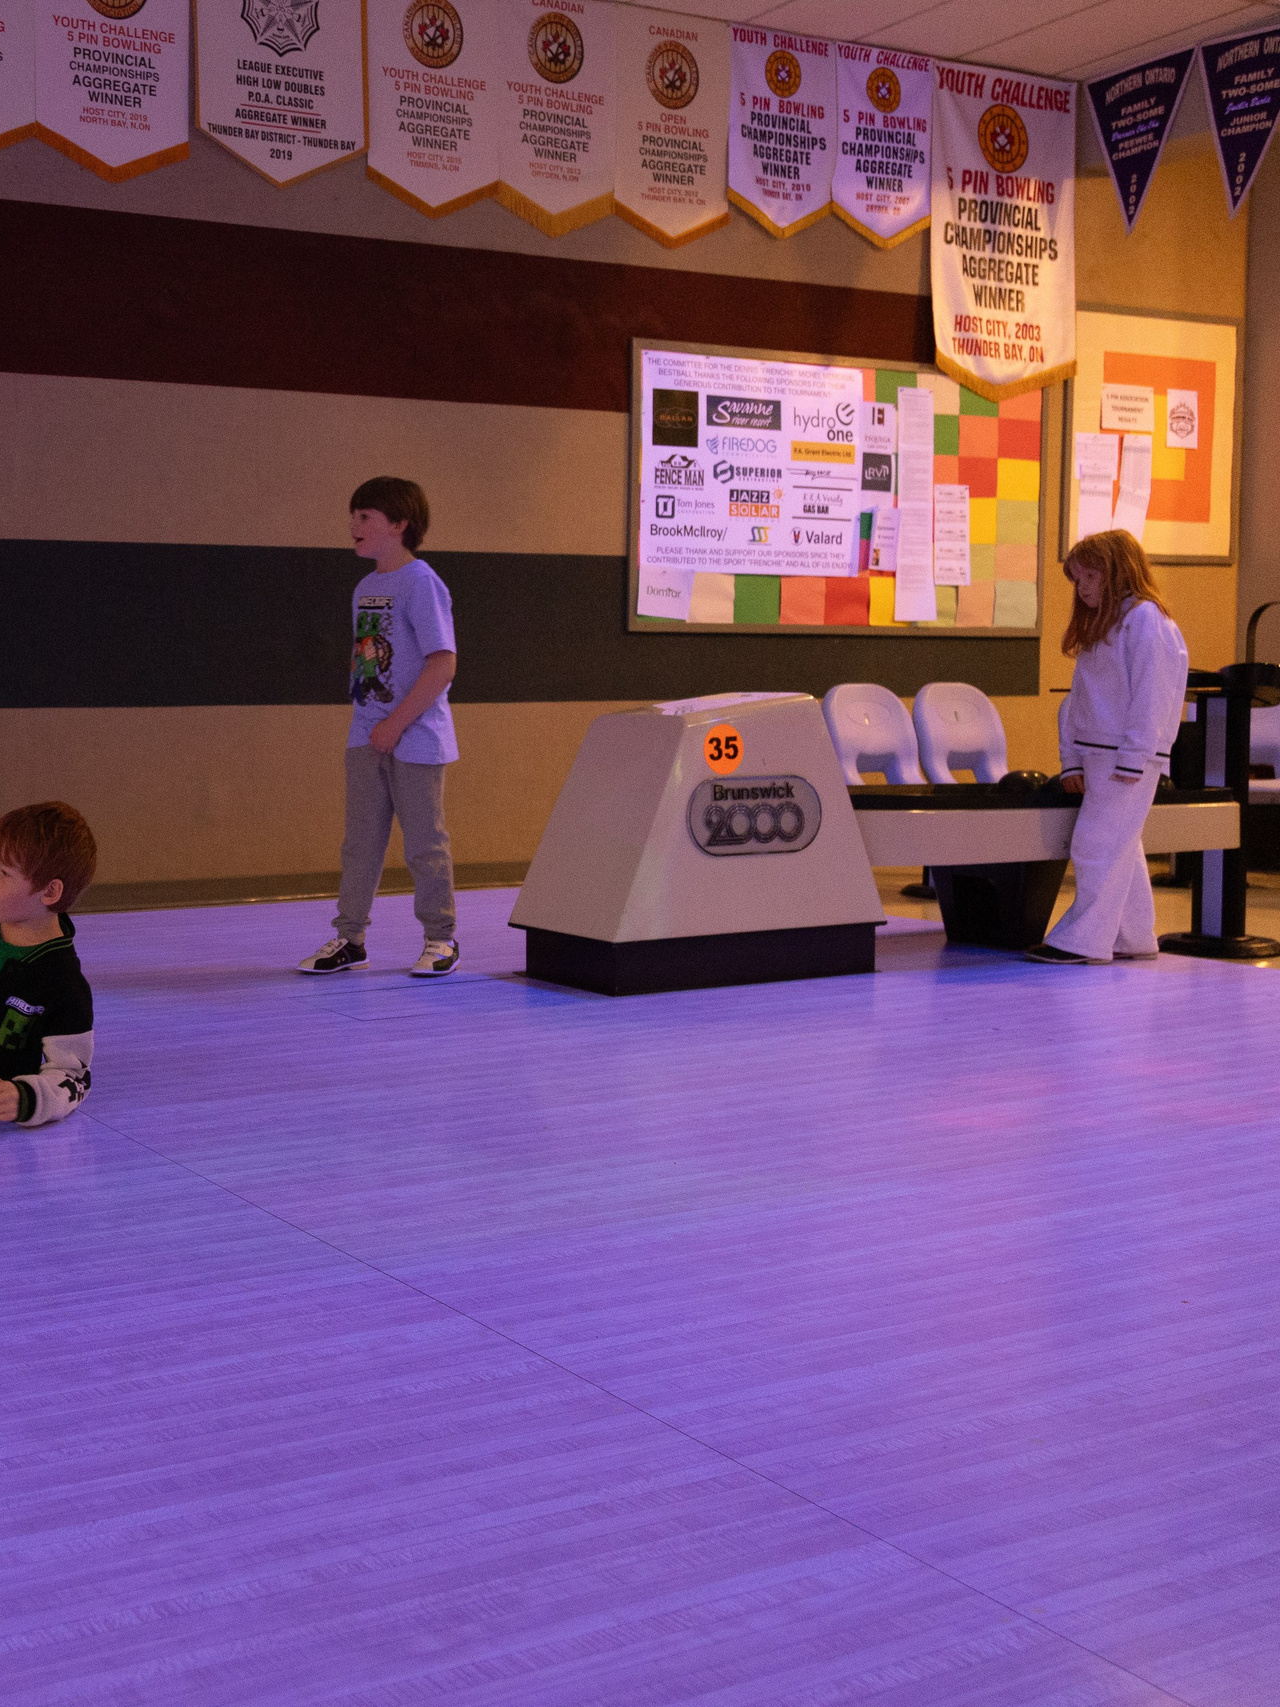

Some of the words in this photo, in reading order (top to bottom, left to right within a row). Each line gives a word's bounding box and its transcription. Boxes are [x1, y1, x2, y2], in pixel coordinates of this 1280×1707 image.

[532, 0, 584, 14] CANADIAN
[52, 14, 96, 32] YOUTH
[99, 22, 176, 44] CHALLENGE
[649, 25, 698, 41] CANADIAN
[67, 30, 74, 41] 5
[78, 32, 98, 46] PIN
[102, 36, 162, 54] BOWLING
[732, 27, 767, 46] YOUTH
[773, 33, 829, 58] CHALLENGE
[73, 47, 156, 69] PROVINCIAL
[837, 43, 871, 63] YOUTH
[876, 50, 930, 72] CHALLENGE
[69, 60, 160, 82] CHAMPIONSHIPS
[237, 59, 272, 74] LEAGUE
[275, 64, 324, 81] EXECUTIVE
[382, 66, 419, 81] YOUTH
[421, 72, 486, 91] CHALLENGE
[1234, 67, 1275, 85] FAMILY
[72, 74, 157, 97] AGGREGATE
[236, 74, 259, 88] HIGH
[261, 78, 281, 90] LOW
[284, 81, 325, 96] DOUBLES
[394, 81, 401, 90] 5
[403, 82, 421, 94] PIN
[424, 85, 475, 101] BOWLING
[506, 81, 542, 95] YOUTH
[544, 86, 605, 106] CHALLENGE
[936, 65, 986, 99] YOUTH
[991, 78, 1071, 114] CHALLENGE
[88, 90, 142, 109] WINNER
[248, 91, 273, 104] P.O.A.
[276, 94, 314, 110] CLASSIC
[399, 95, 469, 116] PROVINCIAL
[518, 94, 524, 104] 5
[526, 95, 543, 108] PIN
[546, 98, 593, 116] BOWLING
[740, 92, 746, 106] 5
[752, 95, 771, 111] PIN
[778, 99, 825, 120] BOWLING
[79, 115, 108, 125] NORTH
[82, 106, 105, 116] HOST
[107, 110, 127, 120] CITY,
[235, 108, 288, 125] AGGREGATE
[290, 114, 327, 129] WINNER
[396, 109, 473, 127] CHAMPIONSHIPS
[523, 109, 588, 129] PROVINCIAL
[660, 112, 687, 125] OPEN
[750, 111, 812, 135] PROVINCIAL
[843, 109, 850, 123] 5
[858, 111, 875, 127] PIN
[883, 115, 927, 133] BOWLING
[1230, 111, 1268, 126] JUNIOR
[207, 122, 243, 138] THUNDER
[245, 128, 260, 139] BAY
[260, 130, 296, 144] DISTRICT
[303, 136, 339, 150] THUNDER
[340, 140, 356, 151] BAY
[398, 121, 471, 141] AGGREGATE
[519, 121, 591, 140] CHAMPIONSHIPS
[637, 121, 643, 131] 5
[645, 122, 661, 134] PIN
[664, 124, 709, 139] BOWLING
[741, 124, 827, 151] CHAMPIONSHIPS
[855, 126, 916, 147] PROVINCIAL
[1221, 120, 1273, 137] CHAMPION
[411, 135, 458, 151] WINNER
[521, 133, 590, 153] AGGREGATE
[642, 135, 705, 152] PROVINCIAL
[841, 141, 925, 164] CHAMPIONSHIPS
[269, 148, 293, 160] 2019
[533, 147, 577, 163] WINNER
[639, 147, 708, 162] CHAMPIONSHIPS
[753, 144, 811, 166] AGGREGATE
[641, 159, 706, 176] AGGREGATE
[761, 161, 800, 180] WINNER
[855, 159, 913, 179] AGGREGATE
[652, 171, 694, 186] WINNER
[866, 175, 903, 193] WINNER
[961, 169, 989, 195] PIN
[995, 174, 1055, 205] BOWLING
[958, 197, 1041, 231] PROVINCIAL
[943, 222, 1058, 261] CHAMPIONSHIPS
[962, 254, 1039, 286] AGGREGATE
[972, 283, 1025, 313] WINNER
[954, 314, 983, 334] HOST
[985, 319, 1011, 339] CITY,
[1015, 322, 1041, 341] 2003
[951, 337, 1000, 359] THUNDER
[1003, 342, 1027, 363] BAY,
[1029, 345, 1044, 363] ON
[712, 401, 774, 424] Savanne
[793, 406, 836, 433] hydro
[722, 436, 777, 453] FIREDOG
[826, 429, 854, 442] one
[654, 467, 682, 485] FENCE
[684, 469, 704, 486] MAN
[735, 466, 782, 479] SUPERIOR
[676, 498, 692, 508] Tom
[694, 499, 715, 510] Jones
[730, 490, 769, 503] JAZZ
[730, 504, 779, 517] SOLAR
[803, 504, 816, 513] GAS
[817, 505, 829, 514] BAR
[806, 530, 842, 545] Valard
[708, 736, 739, 761] 35
[713, 782, 795, 801] Brunswick
[704, 802, 806, 847] 2000
